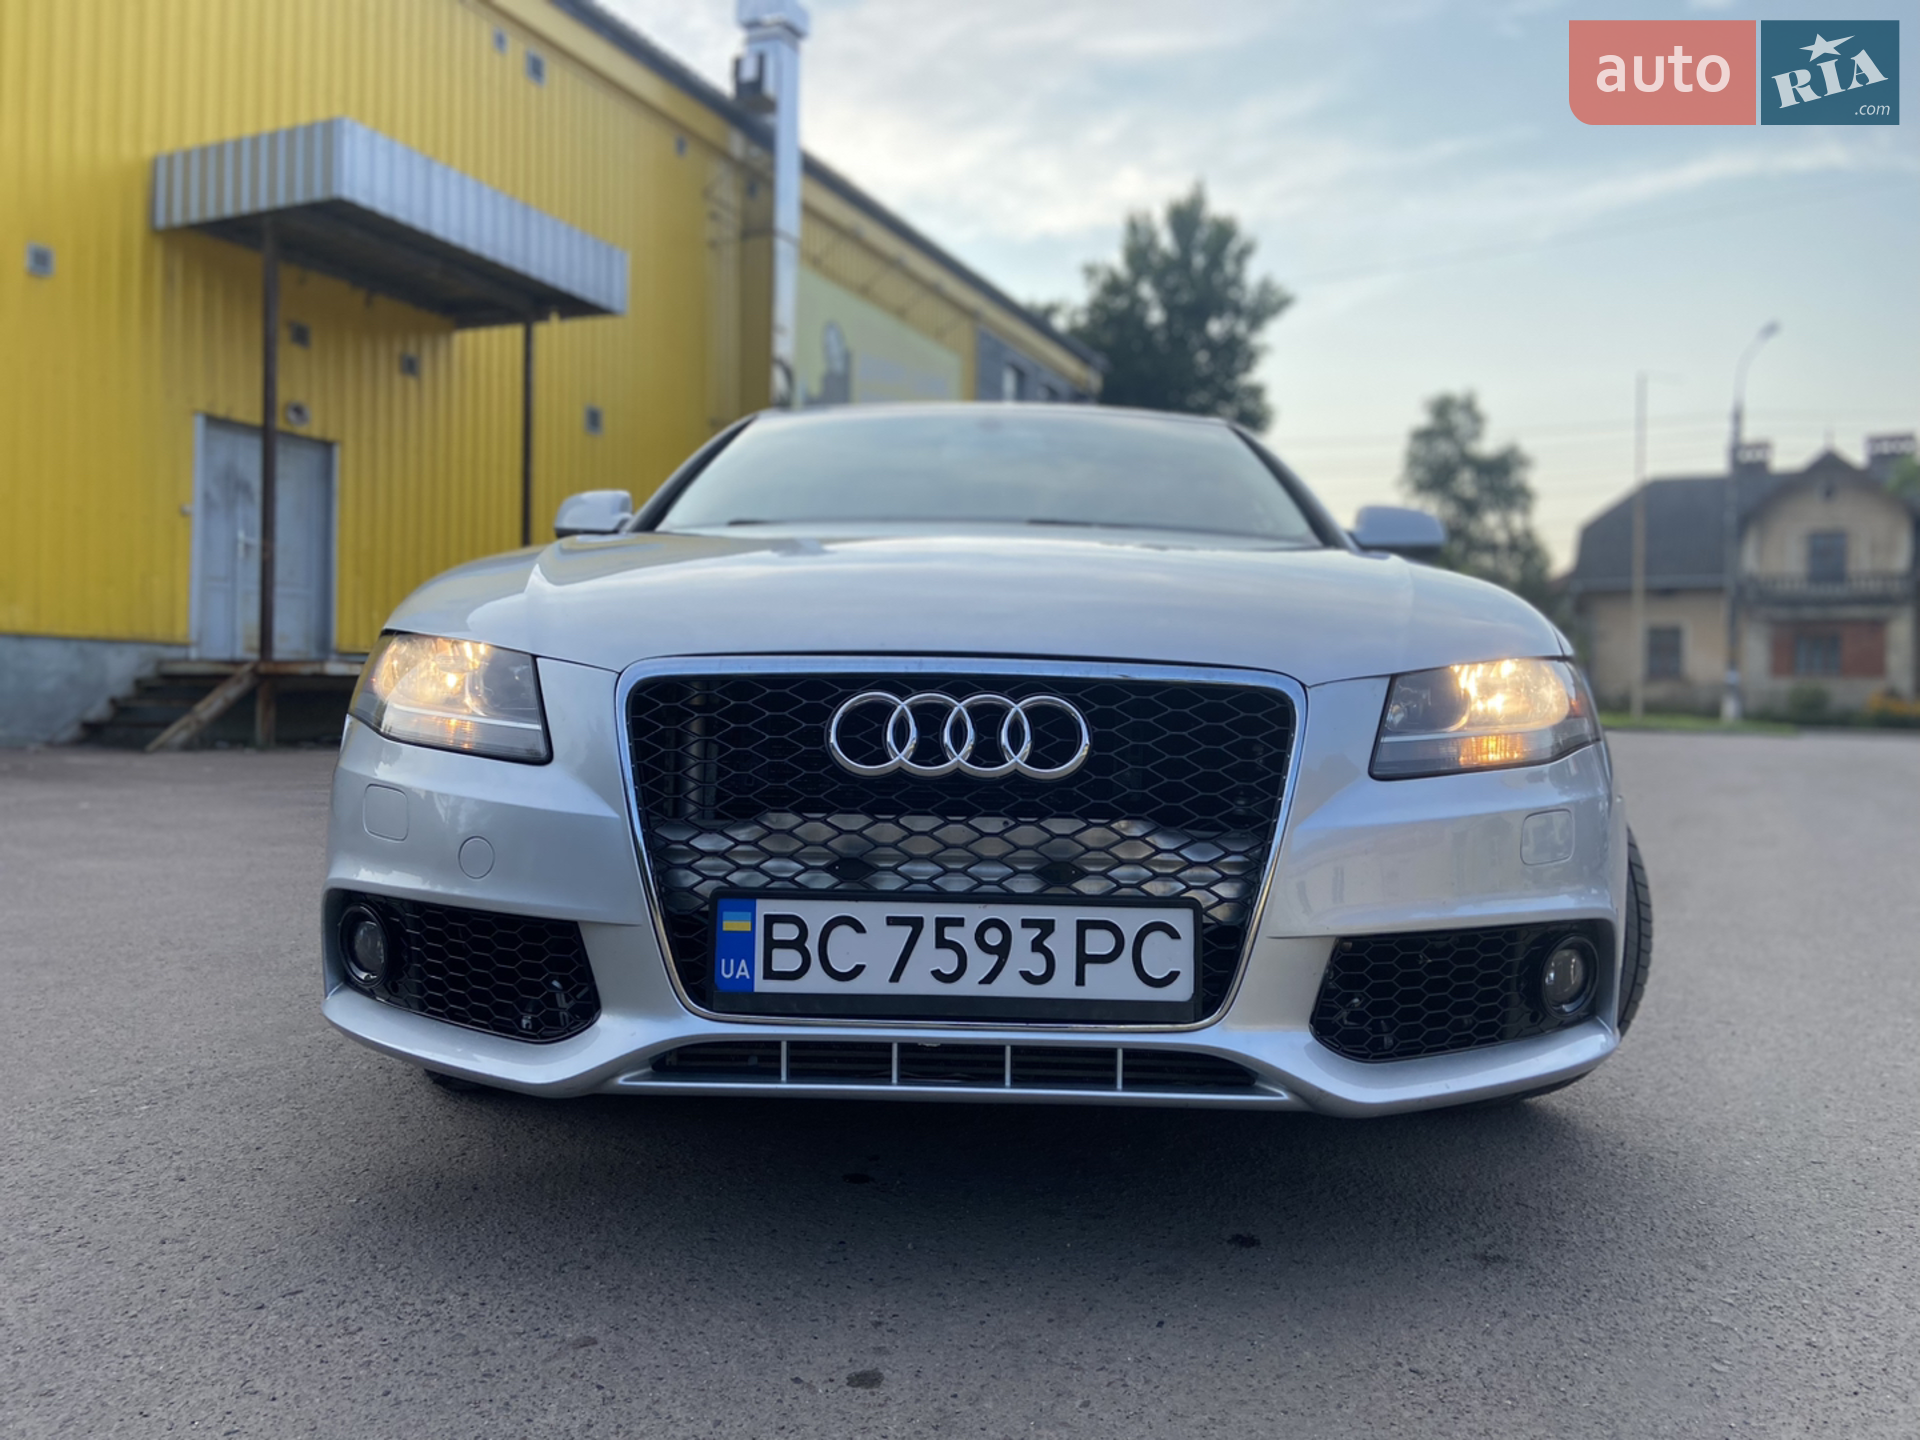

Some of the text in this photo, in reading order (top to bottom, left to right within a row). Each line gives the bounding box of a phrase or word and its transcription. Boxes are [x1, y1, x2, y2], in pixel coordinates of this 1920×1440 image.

[720, 959, 751, 980] UA
[762, 913, 1182, 989] BC 7593 PC
